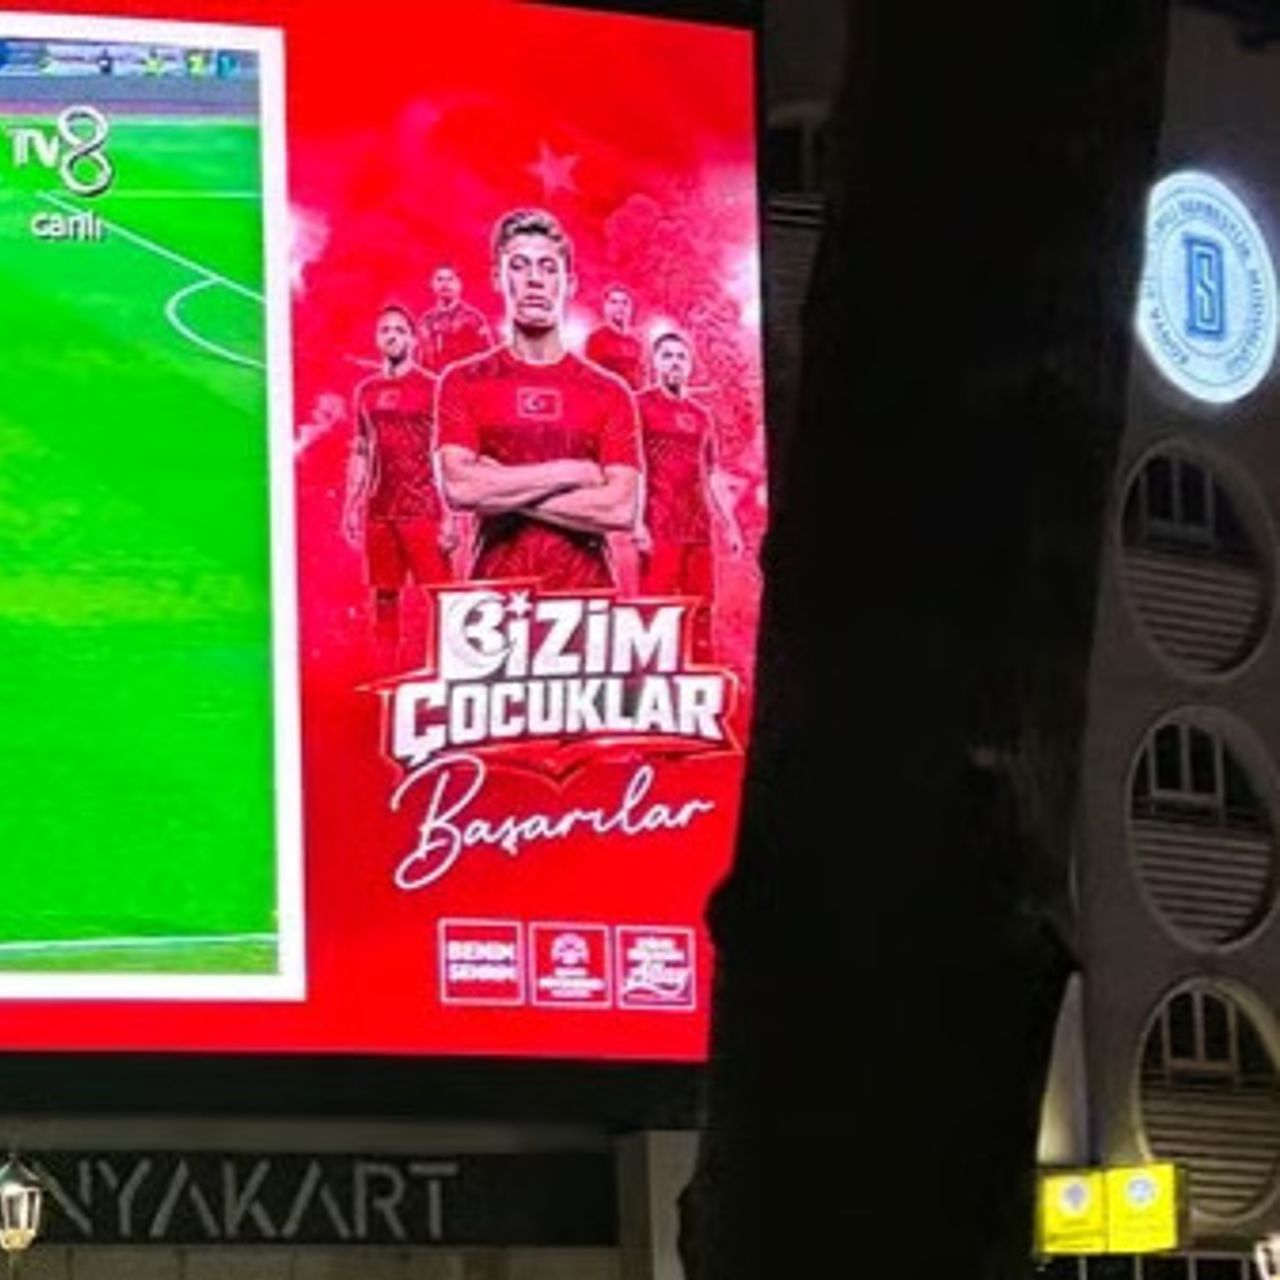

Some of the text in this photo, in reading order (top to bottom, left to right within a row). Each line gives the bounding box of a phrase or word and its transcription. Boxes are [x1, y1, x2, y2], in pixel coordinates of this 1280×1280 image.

[438, 589, 685, 680] BİZİM
[393, 674, 726, 766] ÇOCUKLAR
[390, 753, 715, 889] Başarılar
